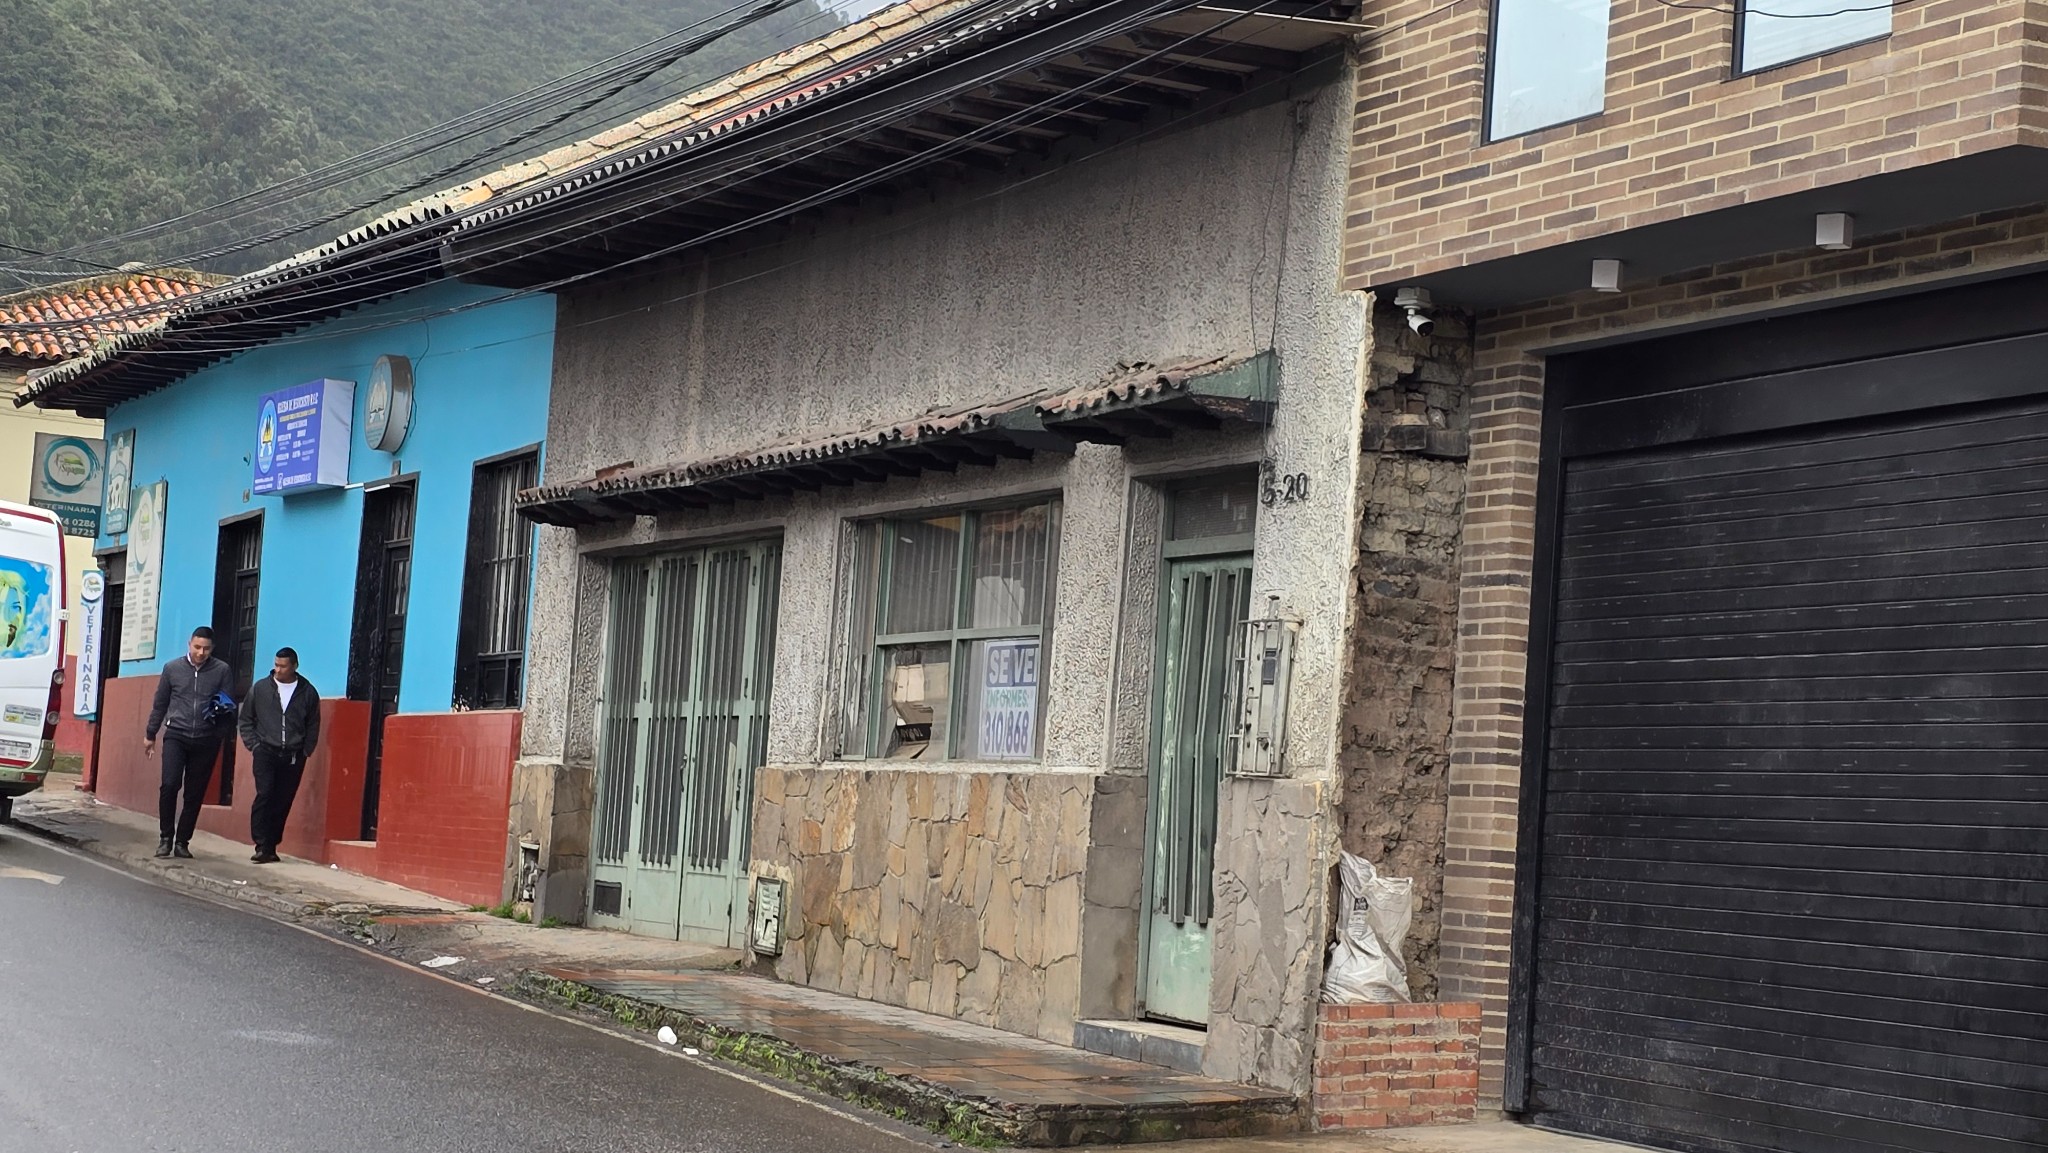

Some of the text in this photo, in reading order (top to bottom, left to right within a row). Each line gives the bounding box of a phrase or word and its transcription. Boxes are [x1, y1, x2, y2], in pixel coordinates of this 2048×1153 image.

[33, 500, 96, 514] VETERINARIA
[72, 518, 96, 529] 0286
[71, 527, 96, 537] 8725
[80, 605, 96, 712] VETERINARIA
[989, 648, 1010, 684] SE
